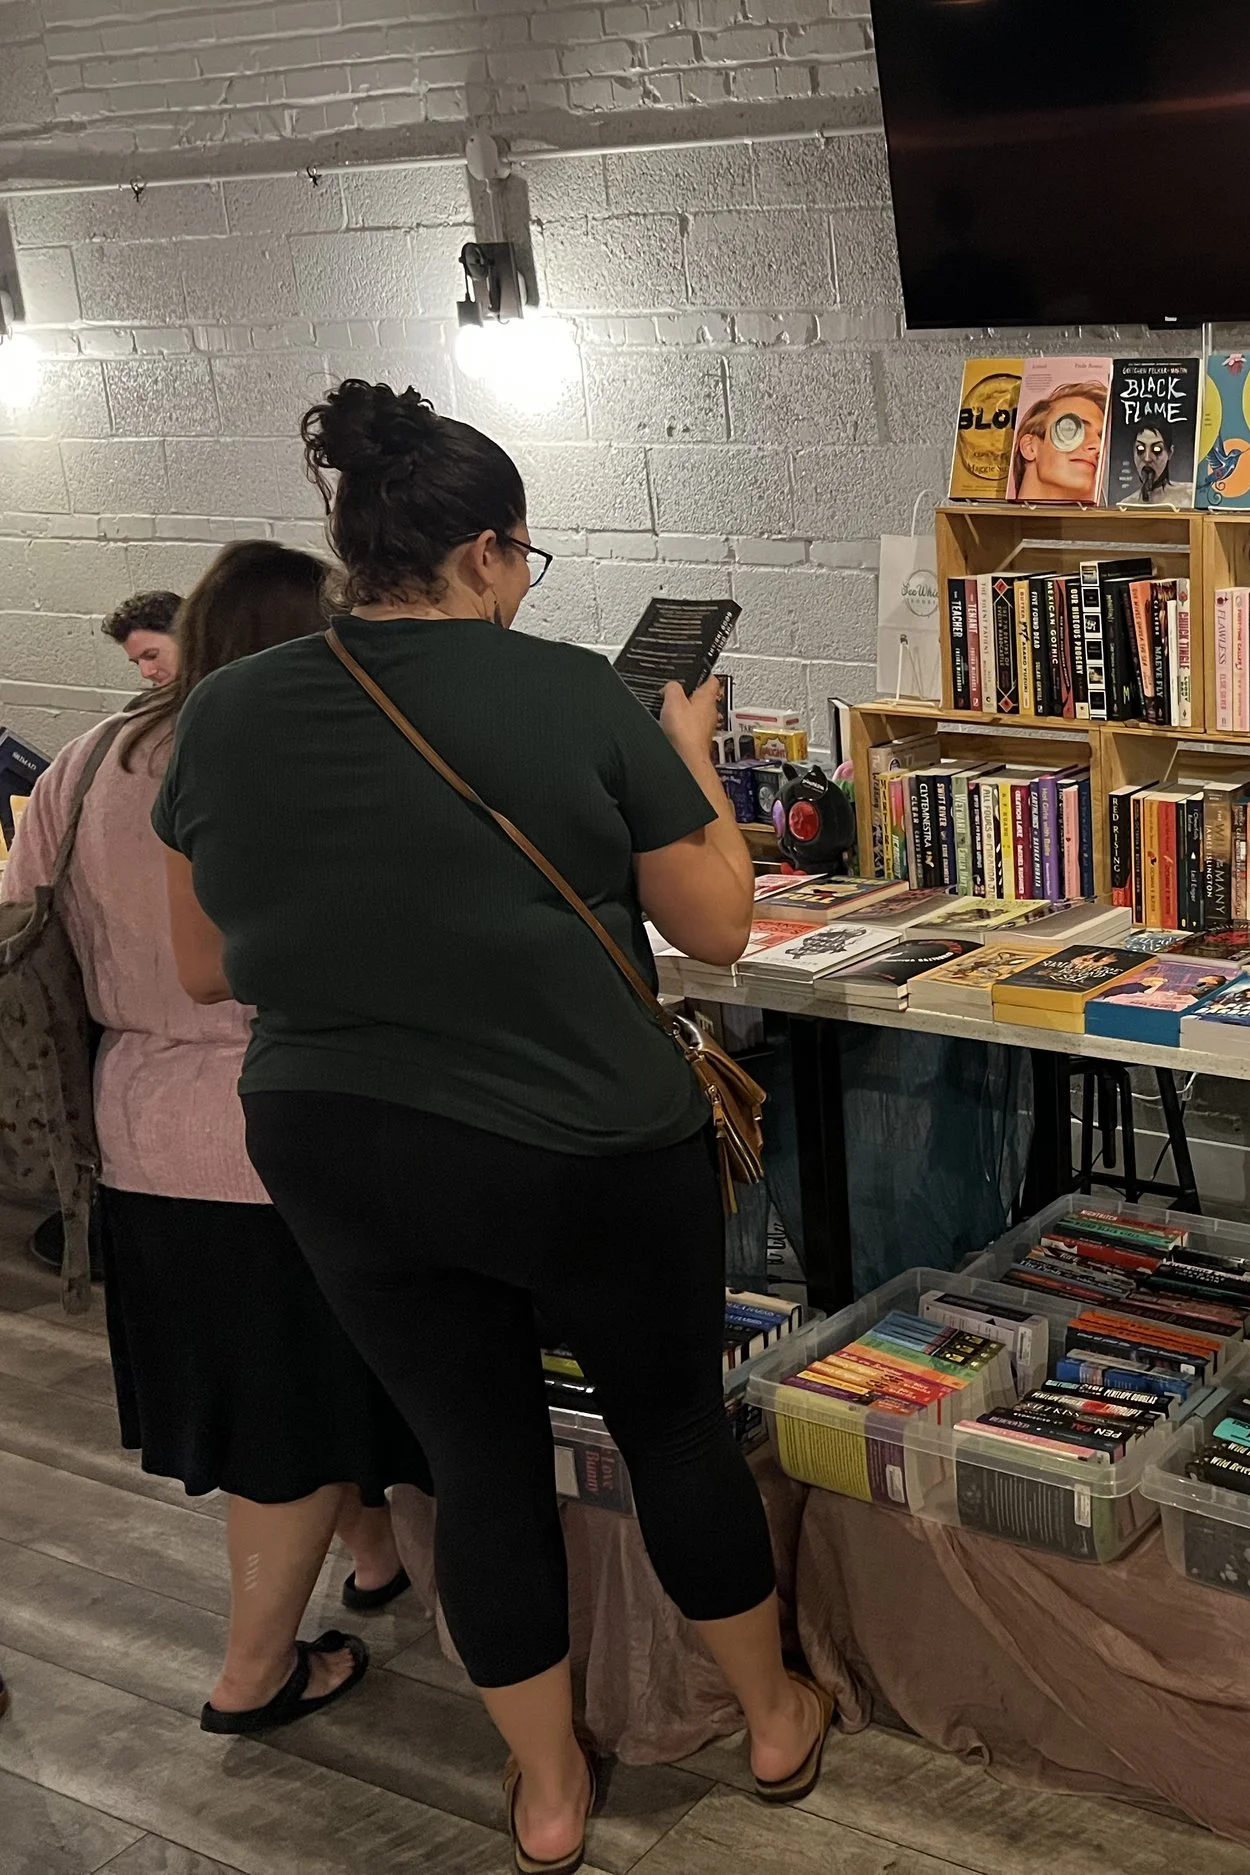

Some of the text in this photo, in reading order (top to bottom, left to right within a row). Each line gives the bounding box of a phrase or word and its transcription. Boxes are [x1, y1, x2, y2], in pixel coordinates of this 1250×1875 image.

[1120, 377, 1187, 400] BLACK
[958, 408, 1017, 430] BLO
[1120, 400, 1187, 424] FLAME
[721, 612, 732, 630] GOOD
[952, 601, 963, 637] TEACHER
[968, 604, 977, 633] TENANT
[1047, 582, 1058, 664] MEXICAN GOTHIC
[1070, 589, 1083, 674] OUR HIDEOUS PROGENY
[1179, 612, 1189, 669] CHUCK TINGLE
[1218, 609, 1226, 665] FLAWLESS
[911, 796, 919, 823] CLEAR
[937, 783, 947, 826] SWIFT RIVER
[983, 789, 991, 803] ALL
[1031, 791, 1039, 829] EARTHLINGS
[920, 784, 932, 848] CLYTEMNESTRA
[955, 794, 966, 833] WEYWARD
[986, 844, 995, 882] MIRANDA
[1113, 825, 1121, 872] RISING
[1215, 870, 1225, 914] MANY
[1080, 1209, 1118, 1221] NIGHTBITCH
[1101, 1404, 1143, 1417] CORRUPT
[1103, 1388, 1158, 1405] PENELOPE DOUGLAS
[1094, 1427, 1122, 1439] PEN
[1228, 1442, 1247, 1454] Wild
[1210, 1456, 1230, 1470] Wild
